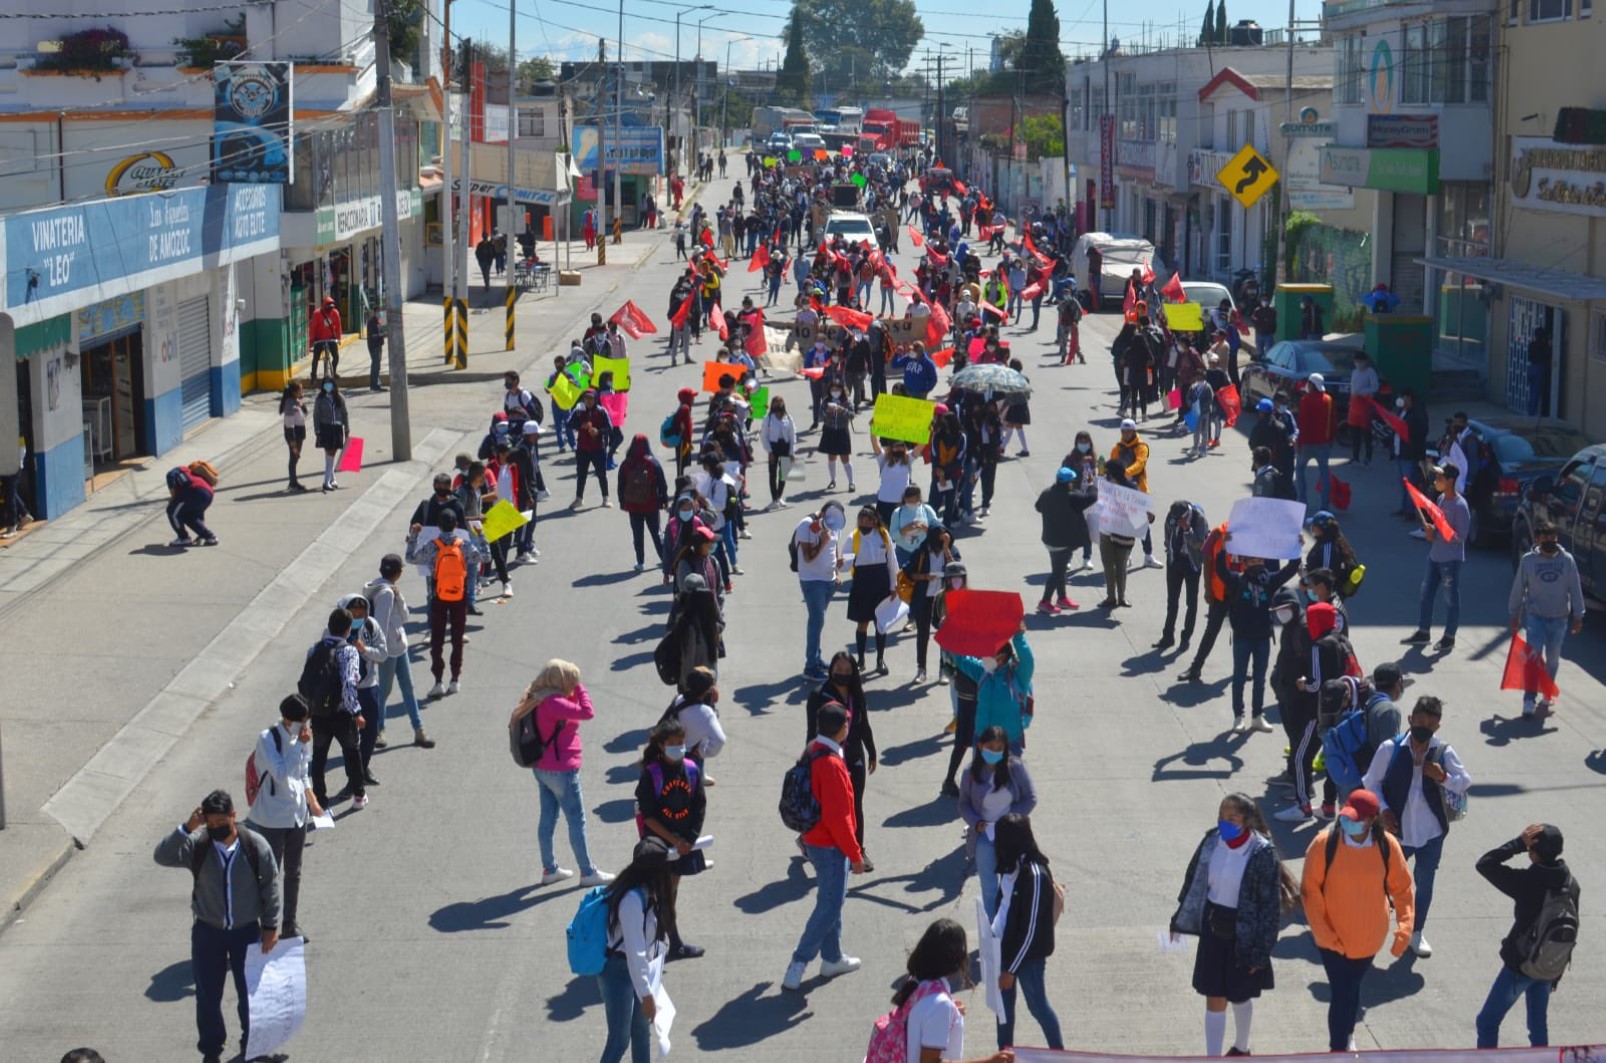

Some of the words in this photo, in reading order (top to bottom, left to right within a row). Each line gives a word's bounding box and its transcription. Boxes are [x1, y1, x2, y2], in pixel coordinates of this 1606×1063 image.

[451, 179, 496, 194] Sper
[32, 214, 85, 252] VINATERIA
[250, 211, 265, 235] ELITE
[337, 206, 369, 234] REFACCIONARIA
[149, 233, 159, 262] DE
[159, 228, 191, 261] AMOZOC
[905, 361, 923, 375] GAP
